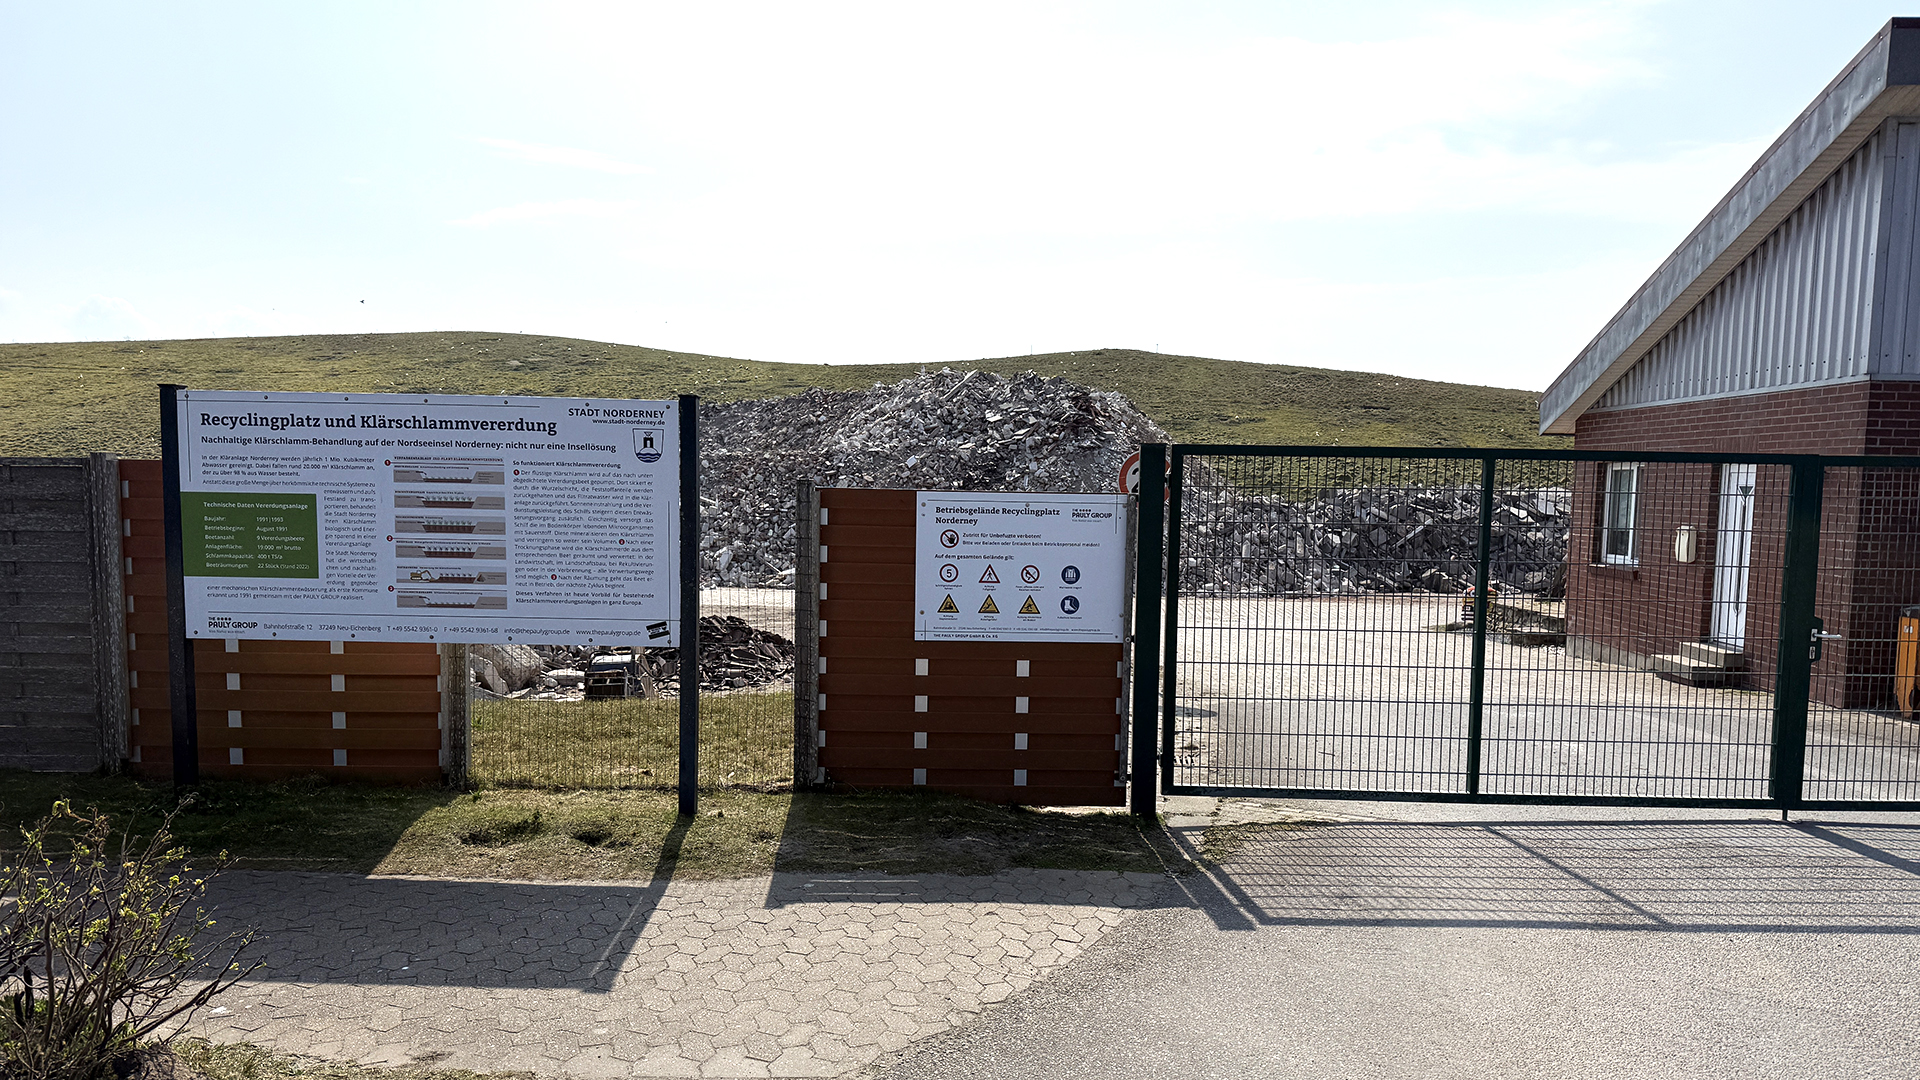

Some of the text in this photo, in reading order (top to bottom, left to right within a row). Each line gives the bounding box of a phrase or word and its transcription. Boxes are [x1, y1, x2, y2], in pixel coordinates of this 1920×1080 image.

[568, 408, 665, 418] STADT NORDERNEY
[201, 412, 557, 434] Recyclingplatz und Klärschlammvererdung
[201, 436, 252, 446] Nachhaltige
[254, 436, 363, 447] Klärschlamm-Behandlung
[398, 439, 452, 447] Nordseeinsel
[455, 440, 503, 450] Norderney:
[568, 443, 616, 453] Insellösung
[936, 506, 1060, 517] Betriebsgelände Recyclingplatz
[936, 517, 978, 526] Norderney
[946, 569, 952, 578] 5
